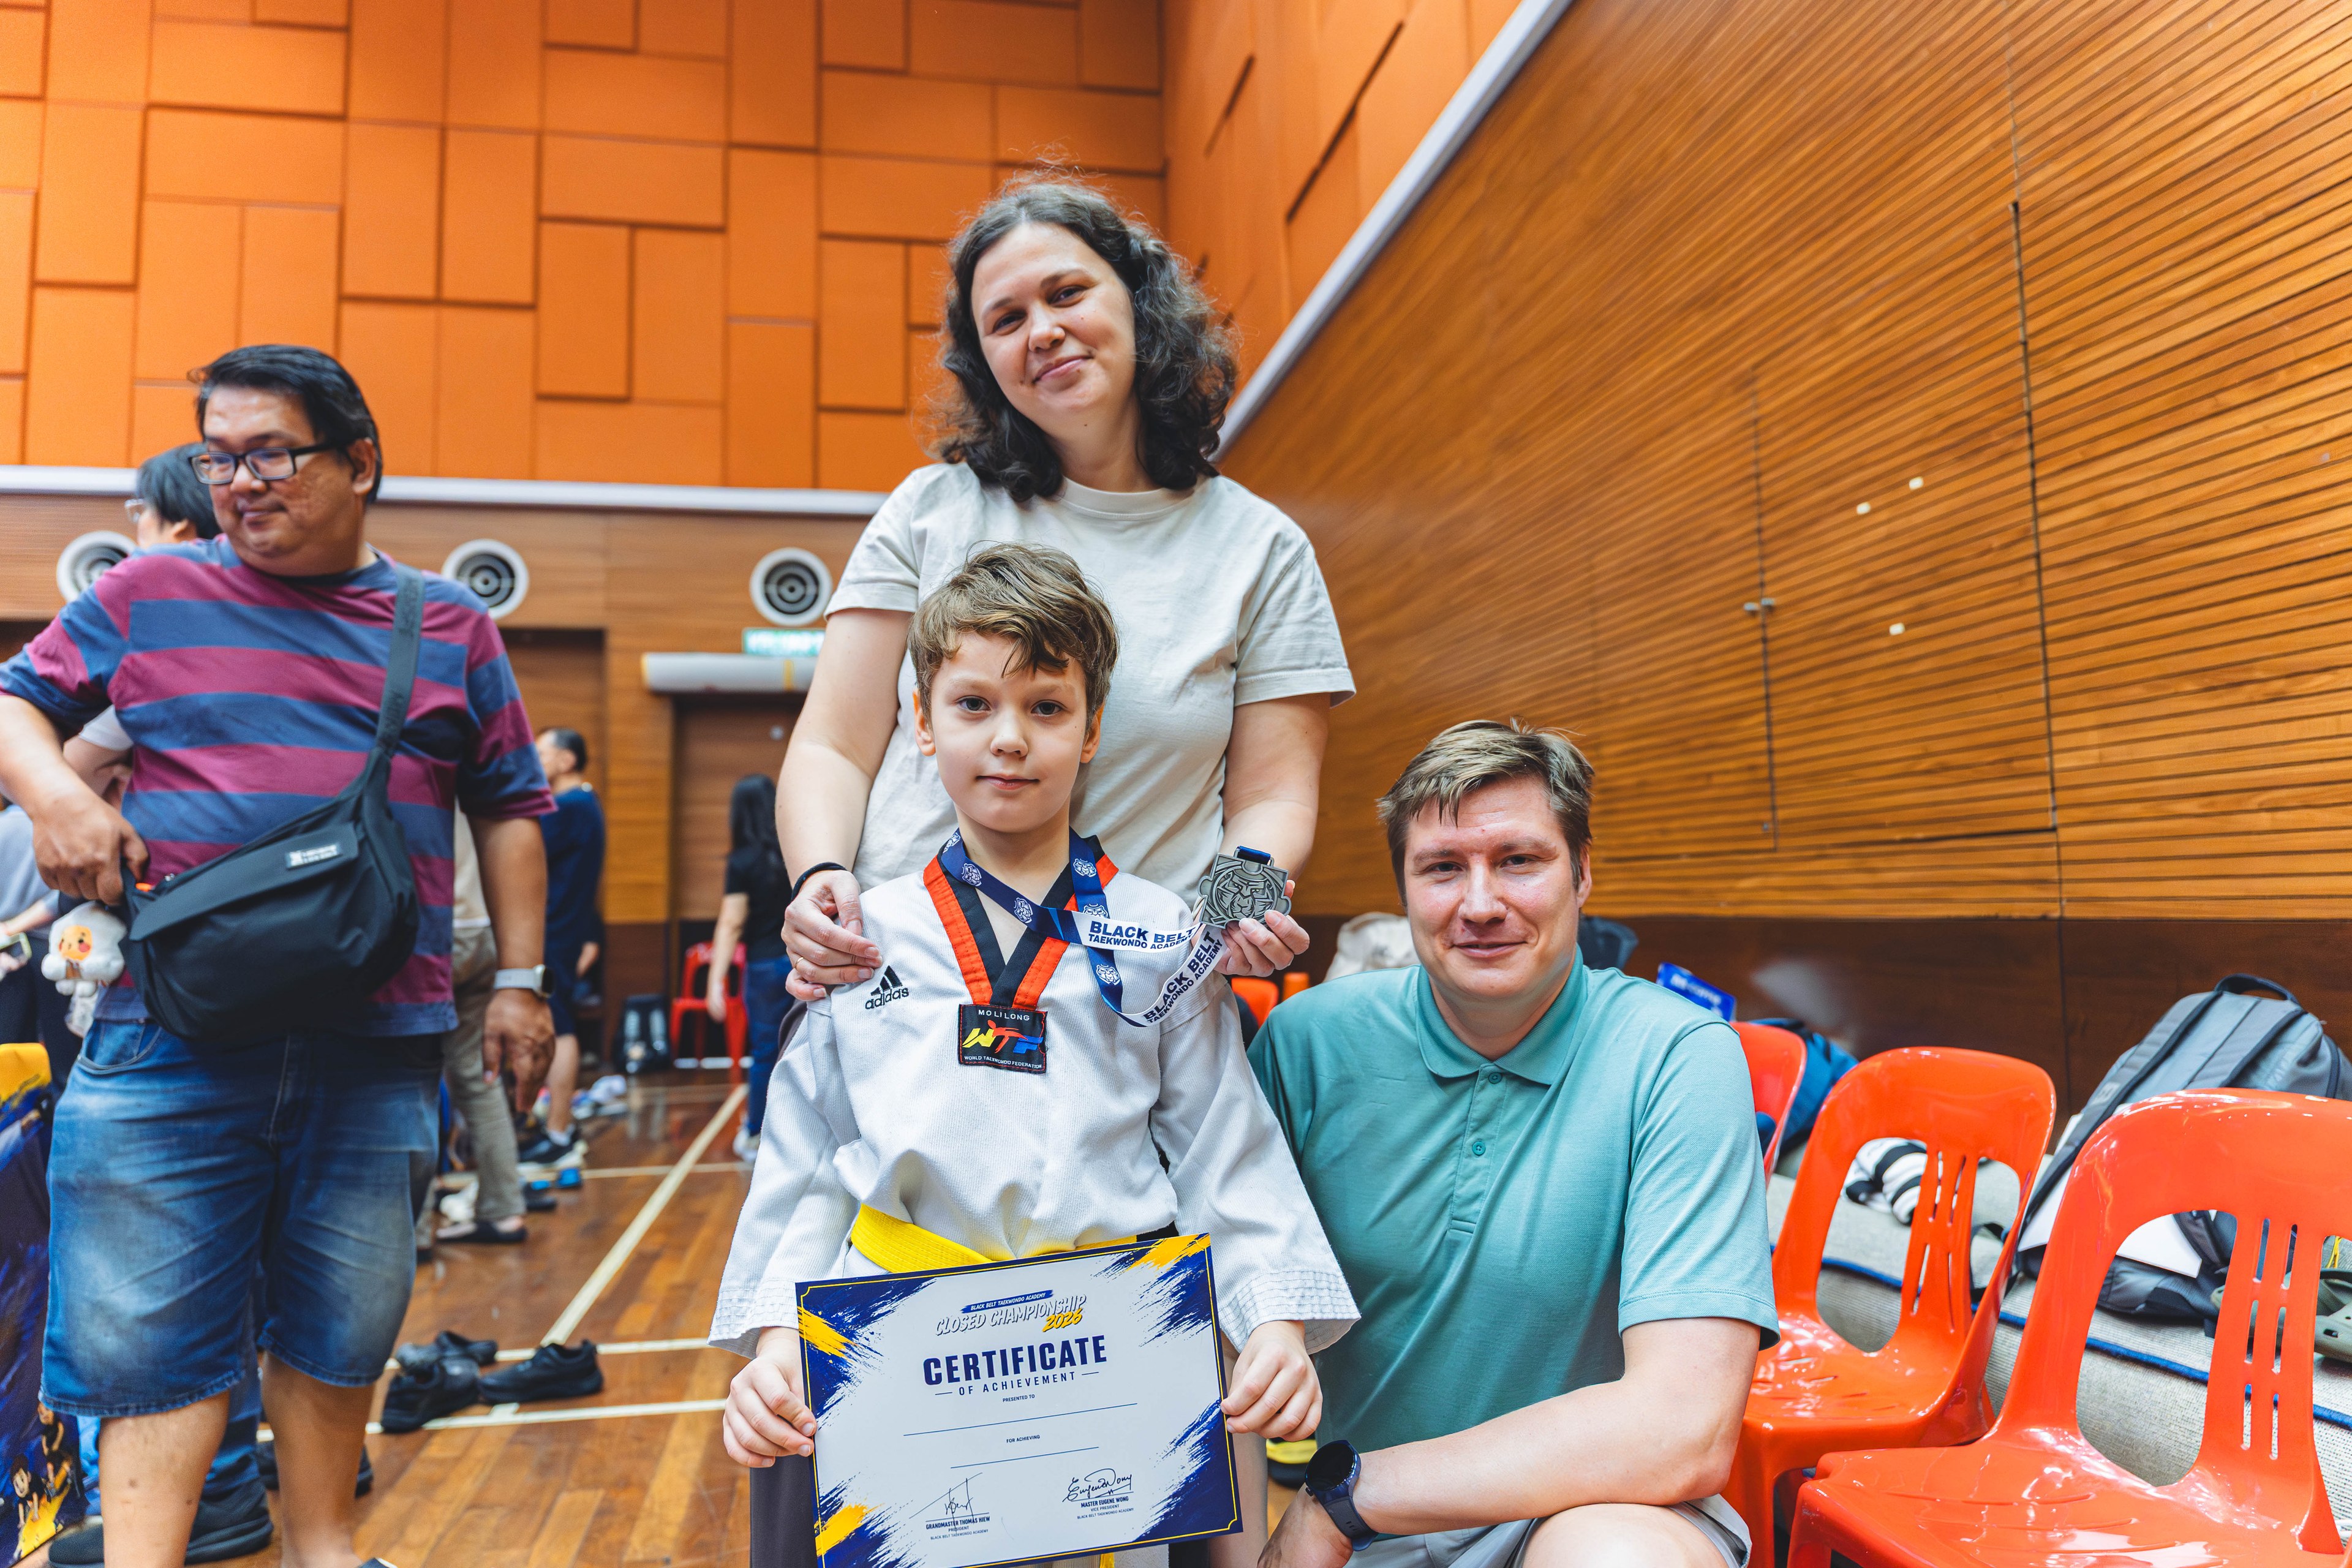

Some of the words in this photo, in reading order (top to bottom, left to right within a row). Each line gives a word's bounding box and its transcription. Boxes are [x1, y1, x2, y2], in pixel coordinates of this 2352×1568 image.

[1088, 933, 1148, 949] TAEKWONDO
[1090, 921, 1149, 941] BLACK
[1154, 927, 1196, 943] BELT
[1143, 971, 1189, 1020] BLACK
[1187, 931, 1215, 973] BELT
[1147, 979, 1194, 1023] TAEKWONDO
[1194, 939, 1223, 981] ACADEMY
[865, 987, 910, 1010] adidas
[984, 1056, 1011, 1065] TAEKWONDO
[997, 1296, 1025, 1305] TAEKWONDO
[935, 1312, 986, 1336] CLOSED
[989, 1293, 1087, 1327] CHAMPIONSHIP
[1042, 1307, 1084, 1333] 2026
[923, 1335, 1107, 1385] CERTIFICATE
[959, 1385, 974, 1396] OF
[982, 1371, 1076, 1393] ACHIEVEMENT
[926, 1520, 959, 1529] GRANDMASTER
